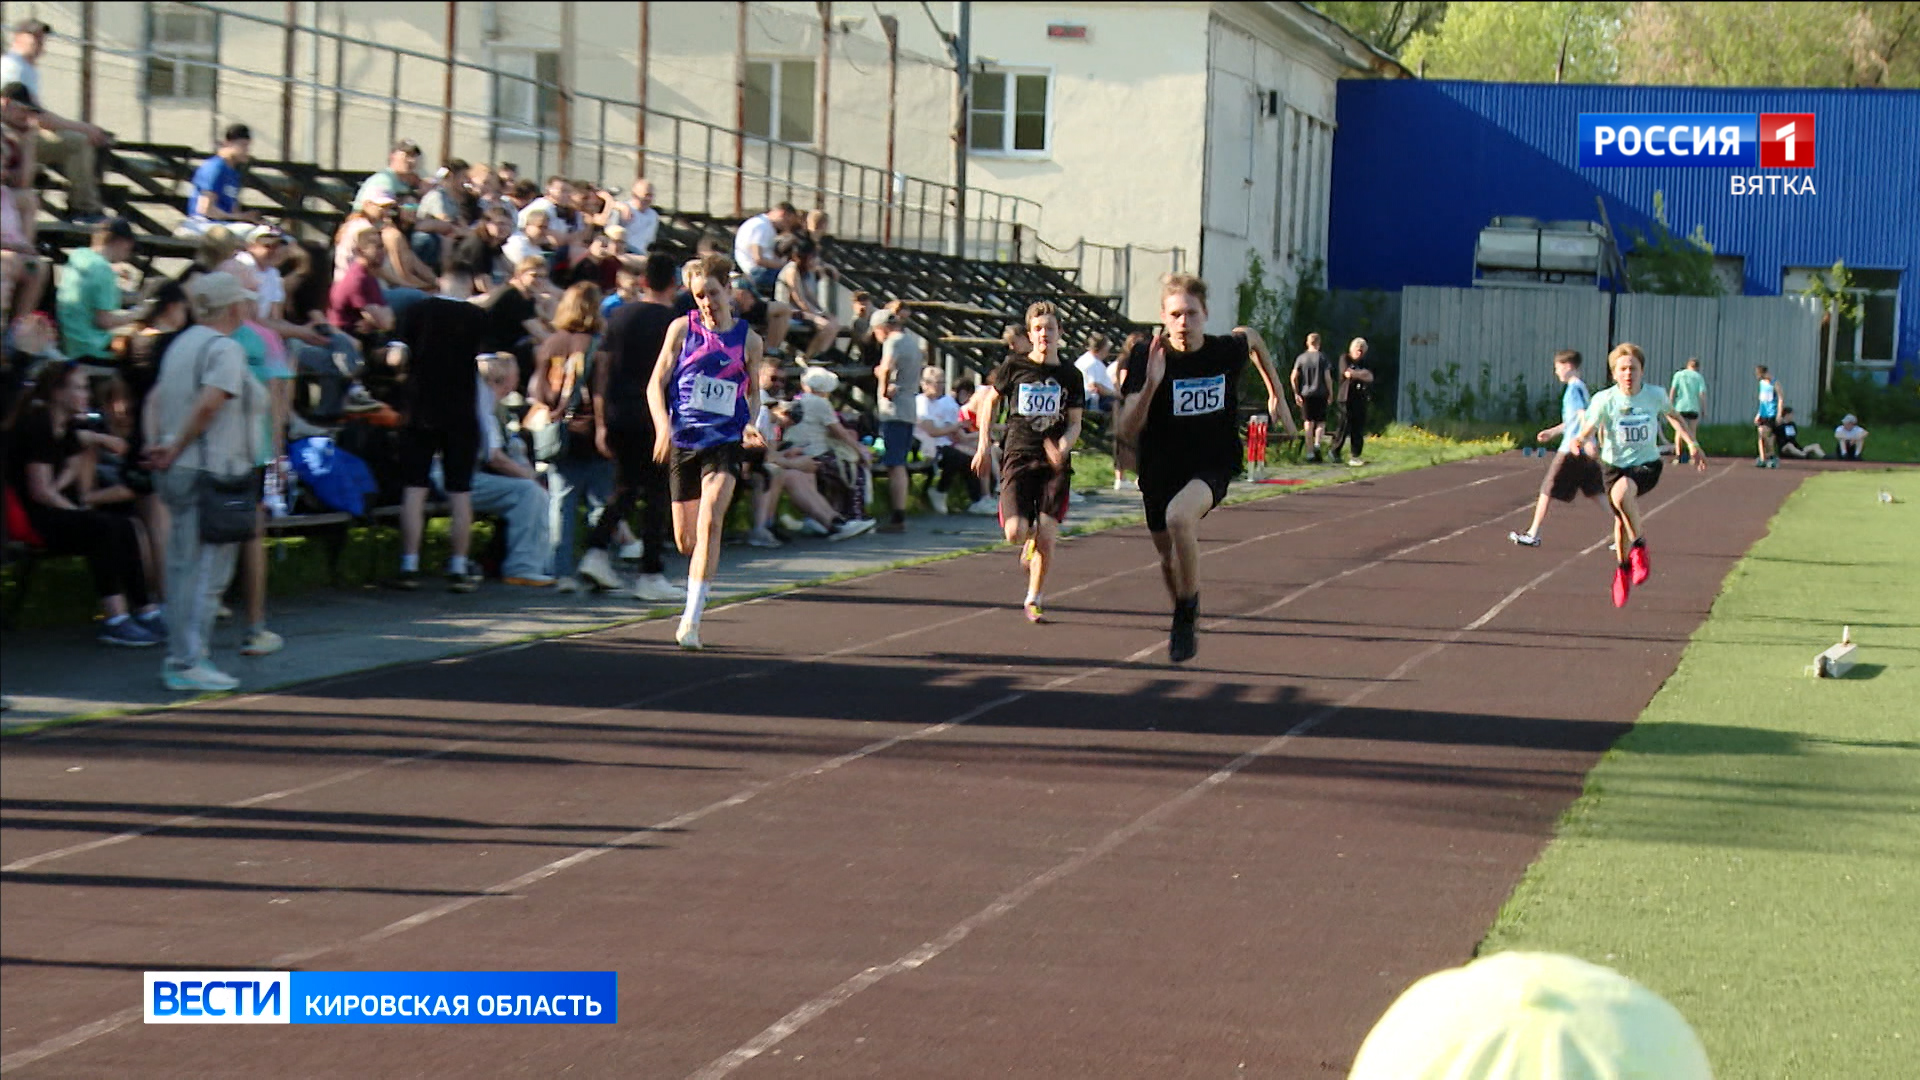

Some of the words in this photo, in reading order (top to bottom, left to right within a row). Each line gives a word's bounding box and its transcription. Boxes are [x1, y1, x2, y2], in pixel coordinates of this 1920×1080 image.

[1023, 394, 1056, 412] 396
[1180, 387, 1220, 412] 205
[1624, 425, 1648, 442] 100
